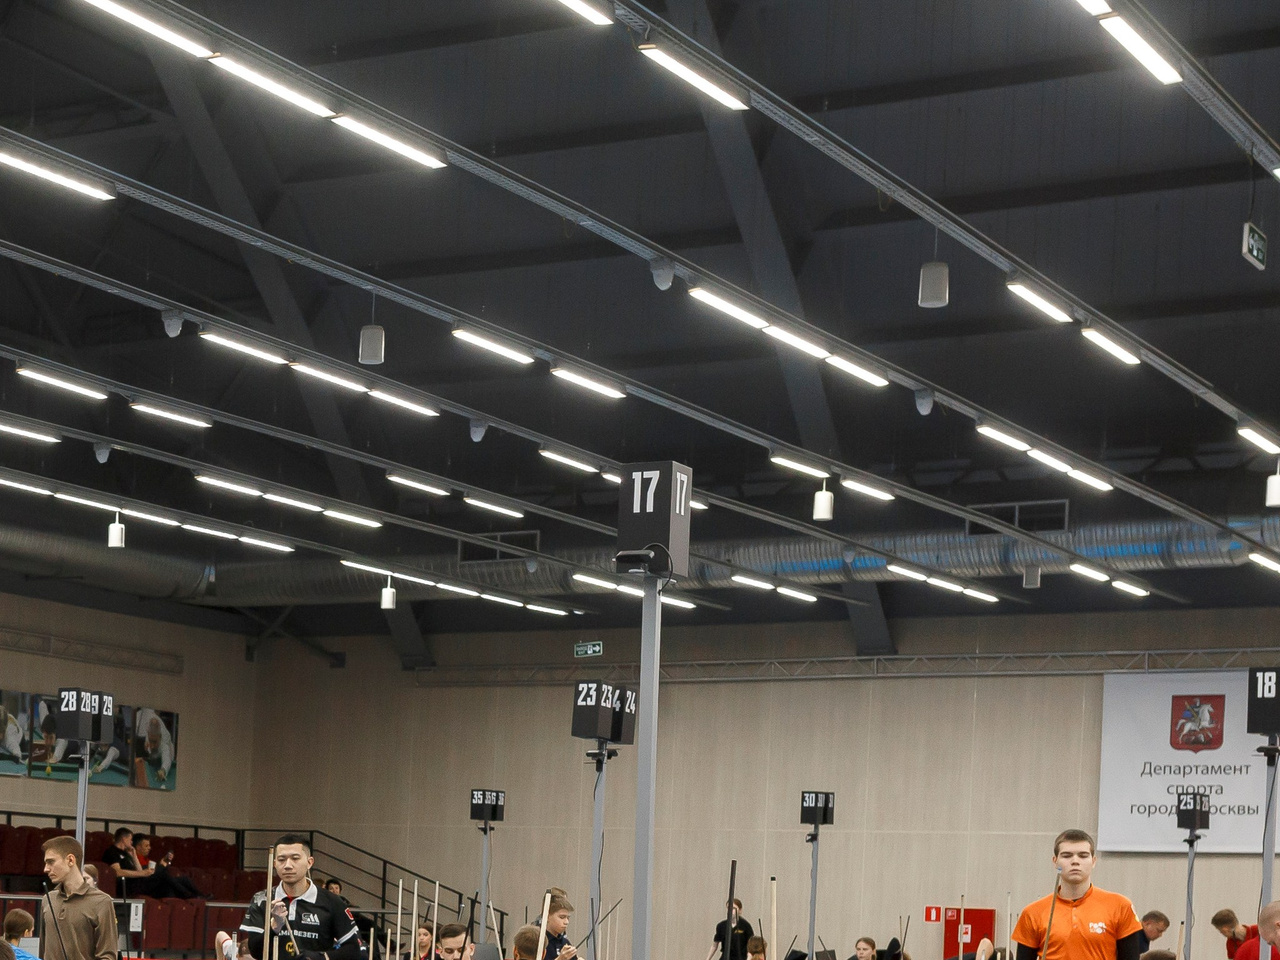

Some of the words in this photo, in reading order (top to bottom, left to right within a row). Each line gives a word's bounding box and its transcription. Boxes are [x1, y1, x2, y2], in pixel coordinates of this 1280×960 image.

[632, 470, 660, 513] 17
[676, 471, 688, 516] 17
[577, 683, 597, 706] 23
[1256, 671, 1276, 698] 18
[60, 691, 77, 711] 28
[81, 691, 91, 712] 28
[91, 695, 99, 715] 9
[103, 695, 113, 716] 29
[601, 684, 613, 708] 23
[612, 689, 621, 712] 4
[625, 690, 636, 715] 24
[1140, 761, 1252, 779] Департамент
[472, 791, 483, 804] 35
[803, 793, 816, 807] 30
[1167, 784, 1224, 796] спорта
[1130, 803, 1178, 819] город
[1209, 804, 1259, 815] осквы
[1179, 794, 1194, 810] 25
